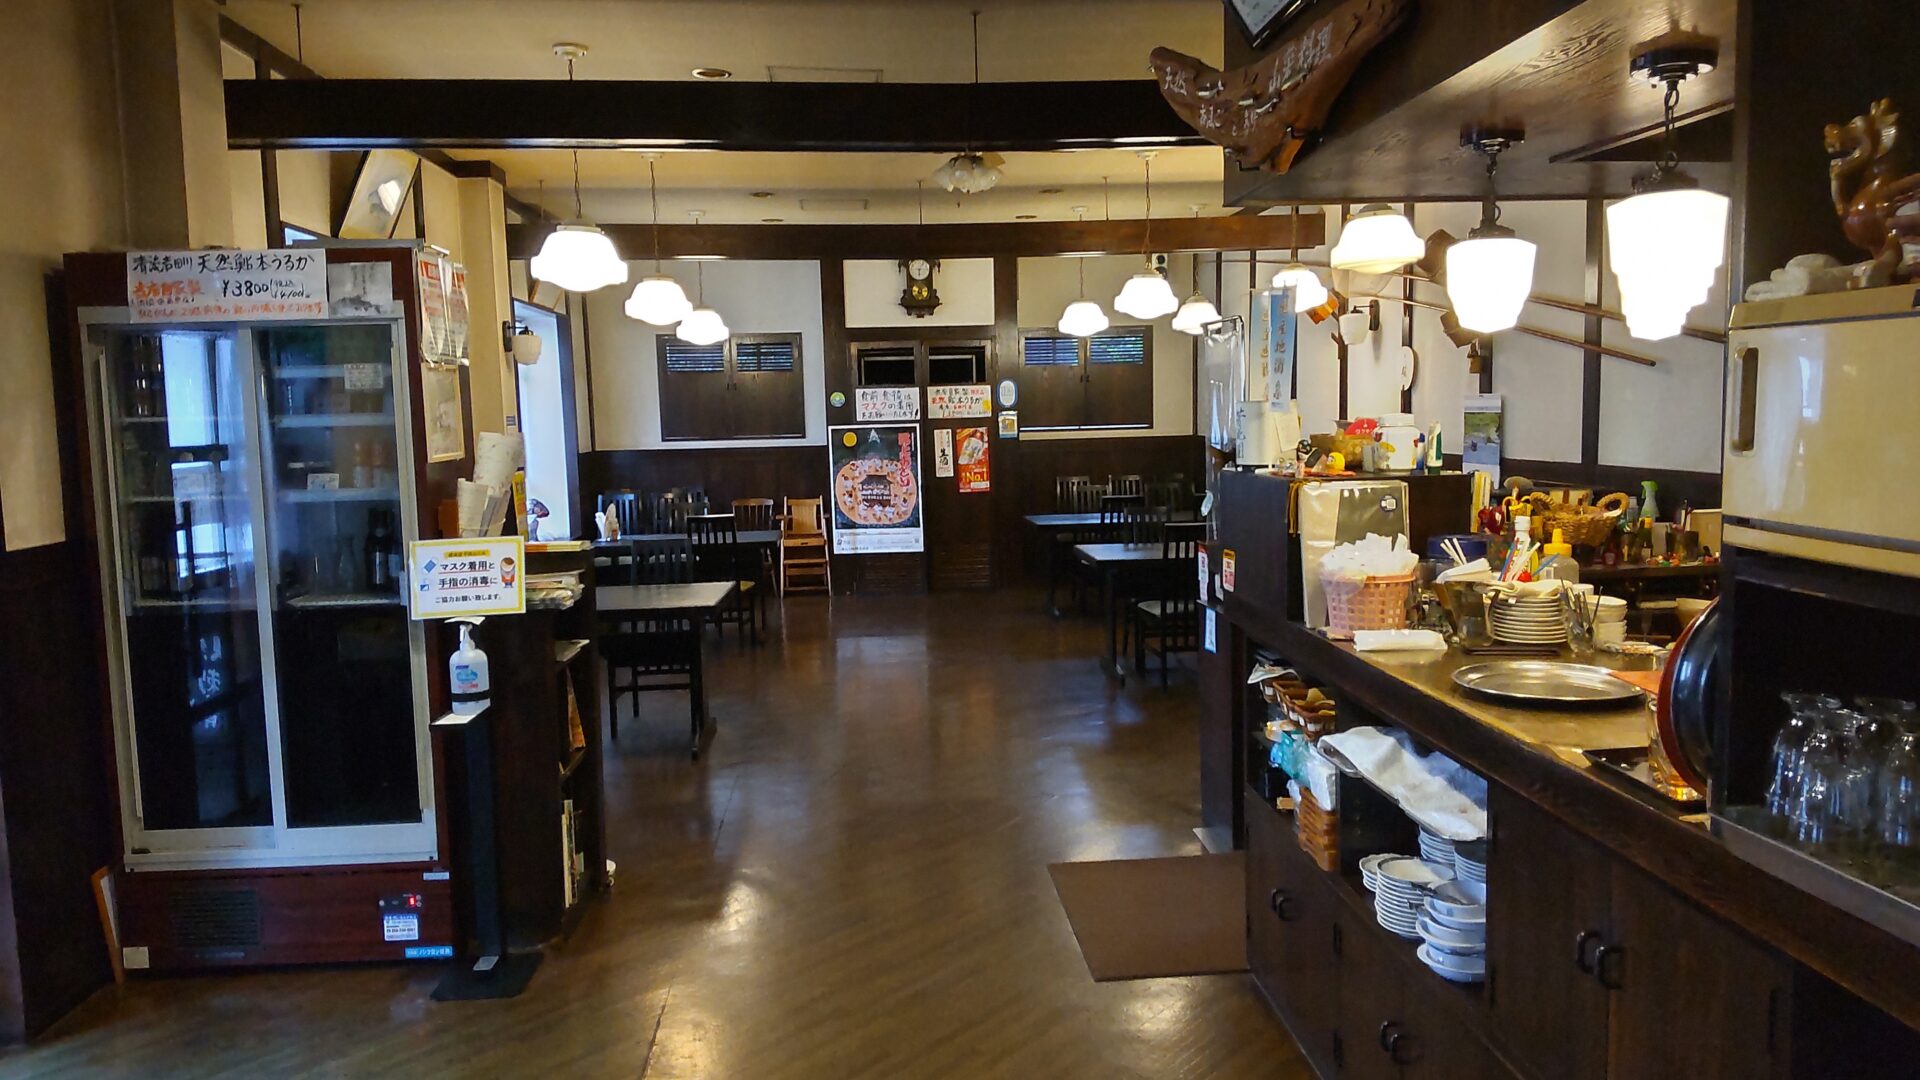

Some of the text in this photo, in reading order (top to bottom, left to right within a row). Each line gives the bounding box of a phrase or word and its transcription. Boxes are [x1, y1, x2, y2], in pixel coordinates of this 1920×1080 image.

[966, 467, 987, 482] No.1
[440, 560, 496, 572] マスク着用と
[438, 576, 498, 589] 手指の消毒に
